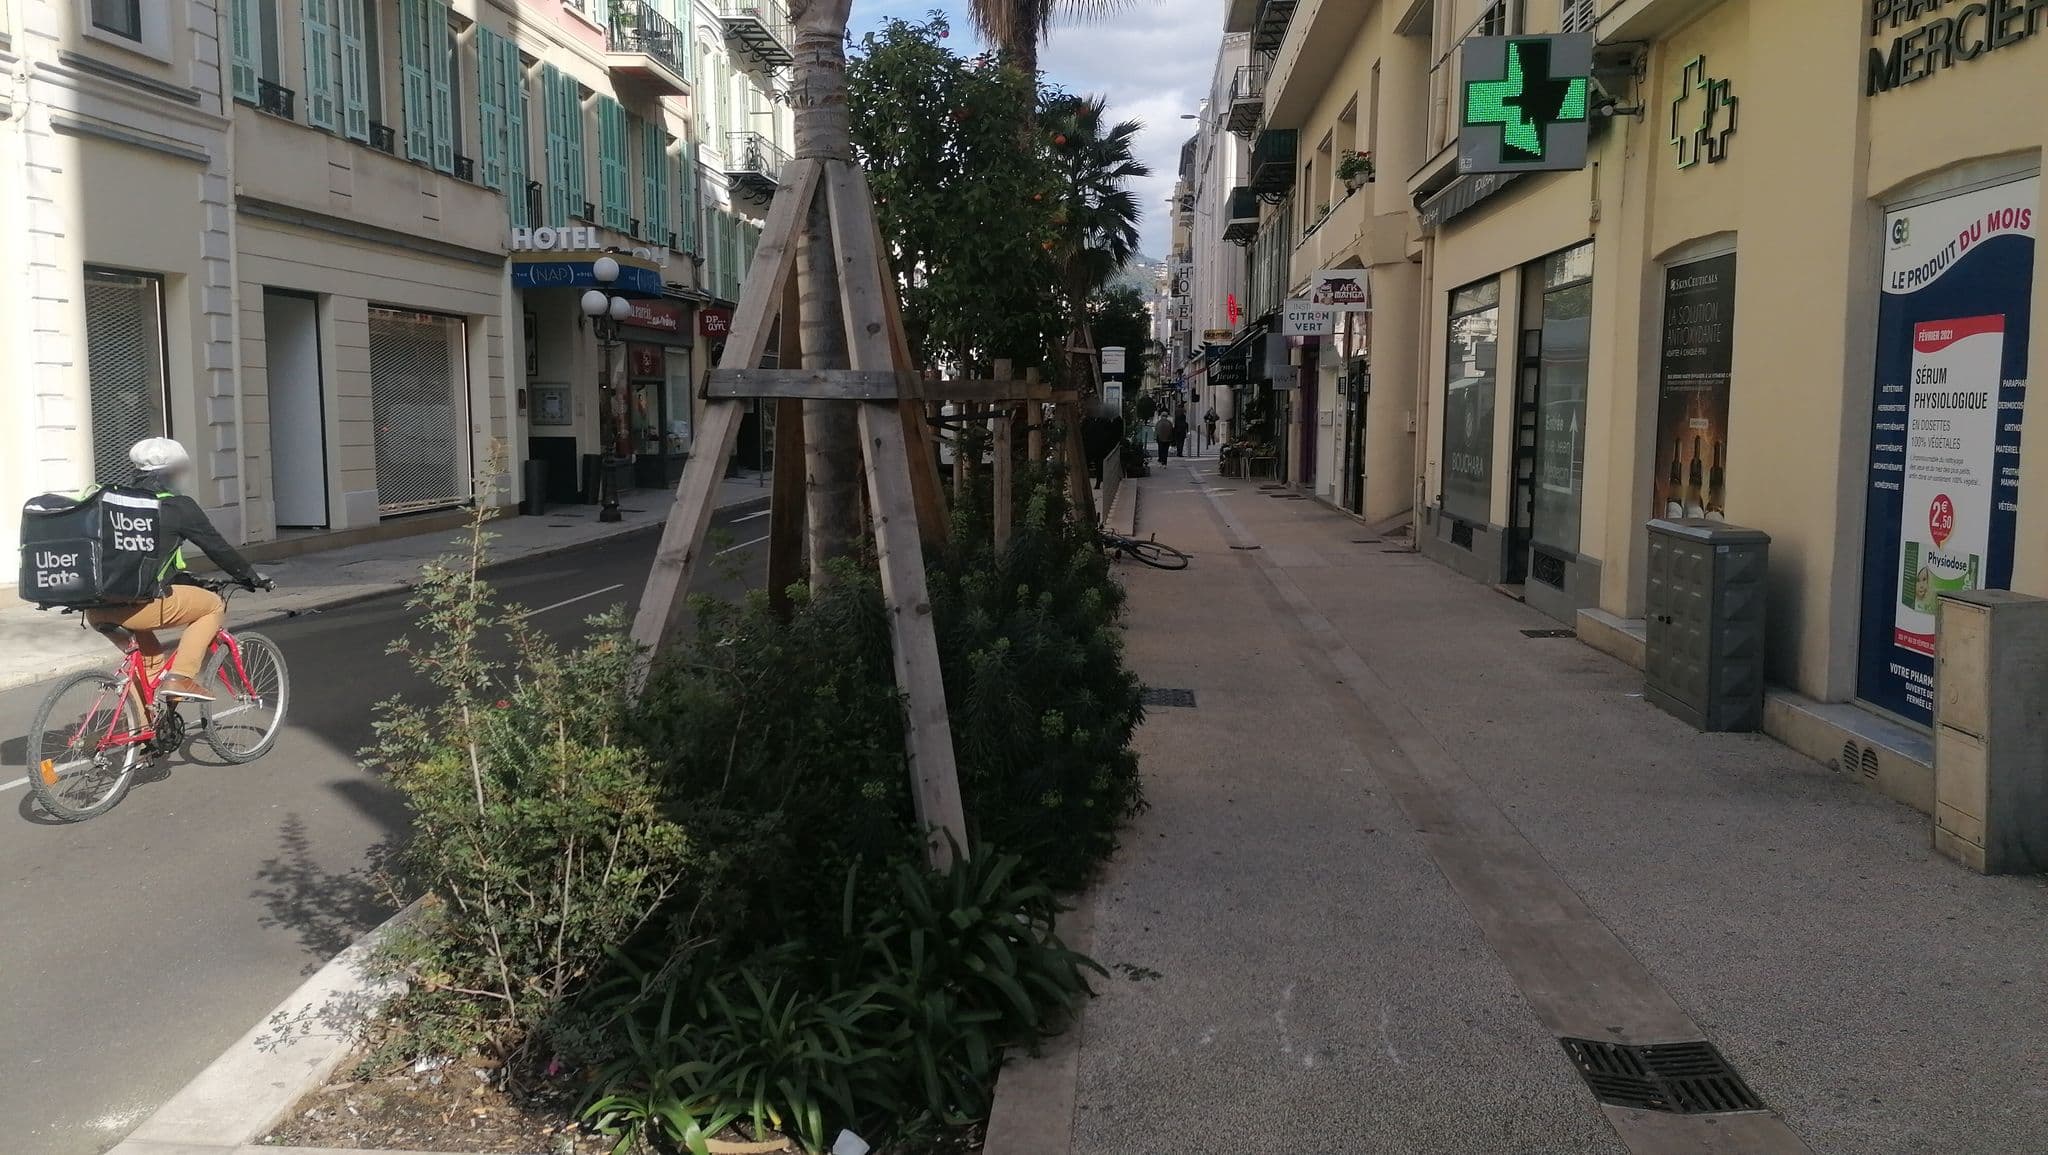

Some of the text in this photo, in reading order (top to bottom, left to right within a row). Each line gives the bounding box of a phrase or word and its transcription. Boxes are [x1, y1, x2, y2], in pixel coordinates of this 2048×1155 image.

[512, 226, 601, 250] HOTEL
[1892, 207, 2032, 289] LE PRODUIT DU MOIS
[1180, 267, 1190, 331] HOTEL
[1289, 312, 1330, 320] CITRON
[1295, 323, 1323, 331] VERT
[1919, 329, 1953, 342] FÉVRIER 2021
[1915, 364, 1947, 384] SÉRUM
[1914, 391, 1988, 409] PHYSIOLOGIQUE
[109, 510, 153, 531] Uber
[114, 531, 155, 552] Eats
[36, 551, 78, 569] Uber
[1928, 551, 1968, 572] Physiodose
[1890, 662, 1910, 679] VOTRE
[1905, 682, 1934, 699] OUVERTE DE
[1906, 693, 1933, 711] FERMÉE LE
